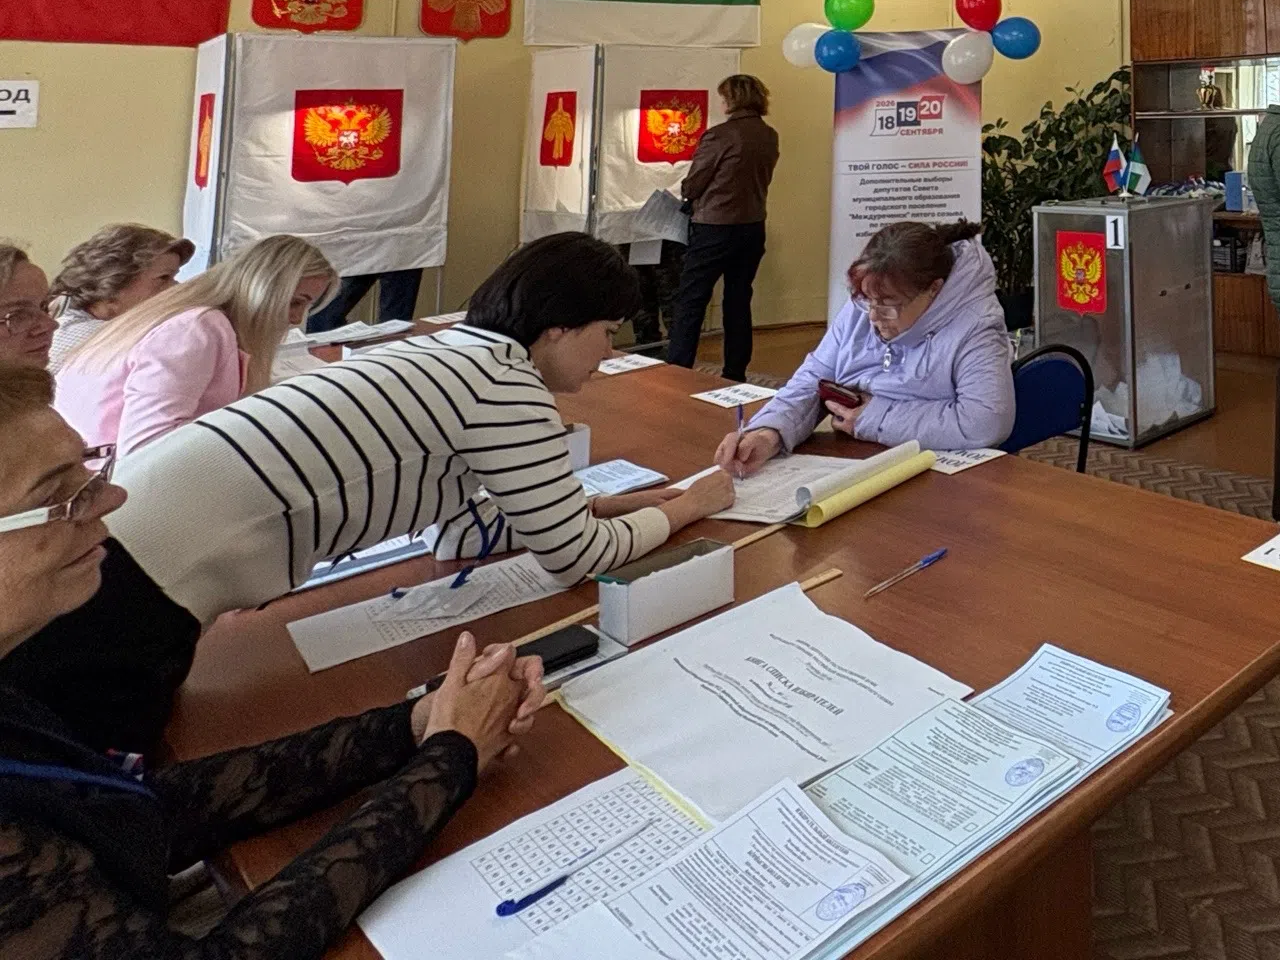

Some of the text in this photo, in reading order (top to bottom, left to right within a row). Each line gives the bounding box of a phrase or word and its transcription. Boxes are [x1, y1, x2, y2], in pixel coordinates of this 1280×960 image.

[878, 100, 941, 130] 18 19 20
[900, 128, 944, 136] СЕНТЯБРЯ
[848, 162, 870, 172] ТВОЙ
[872, 162, 900, 171] ГОЛОС
[908, 162, 930, 170] СИЛА
[1110, 218, 1122, 246] 1
